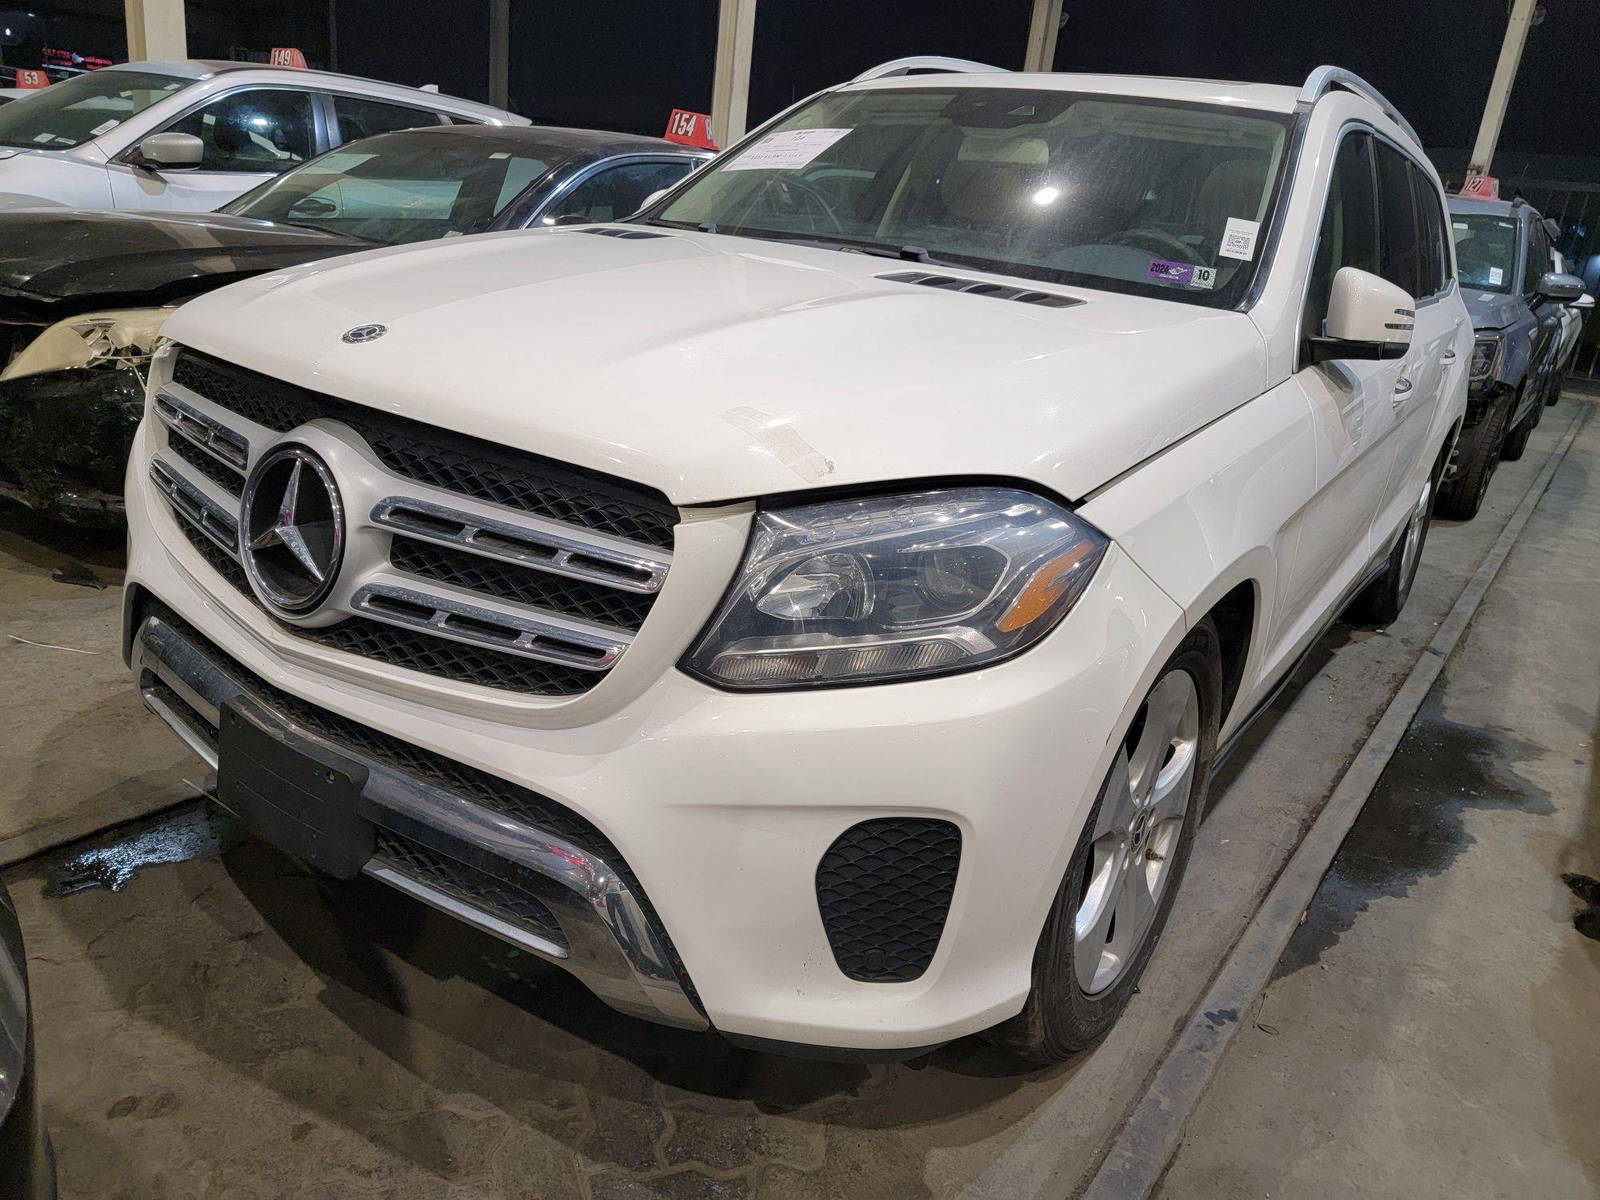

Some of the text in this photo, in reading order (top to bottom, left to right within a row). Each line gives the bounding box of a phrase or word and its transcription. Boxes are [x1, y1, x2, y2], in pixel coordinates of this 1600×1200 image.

[274, 49, 291, 66] 149
[24, 71, 39, 85] 53
[671, 112, 697, 137] 154
[1465, 177, 1485, 193] 127
[1198, 269, 1210, 281] 10
